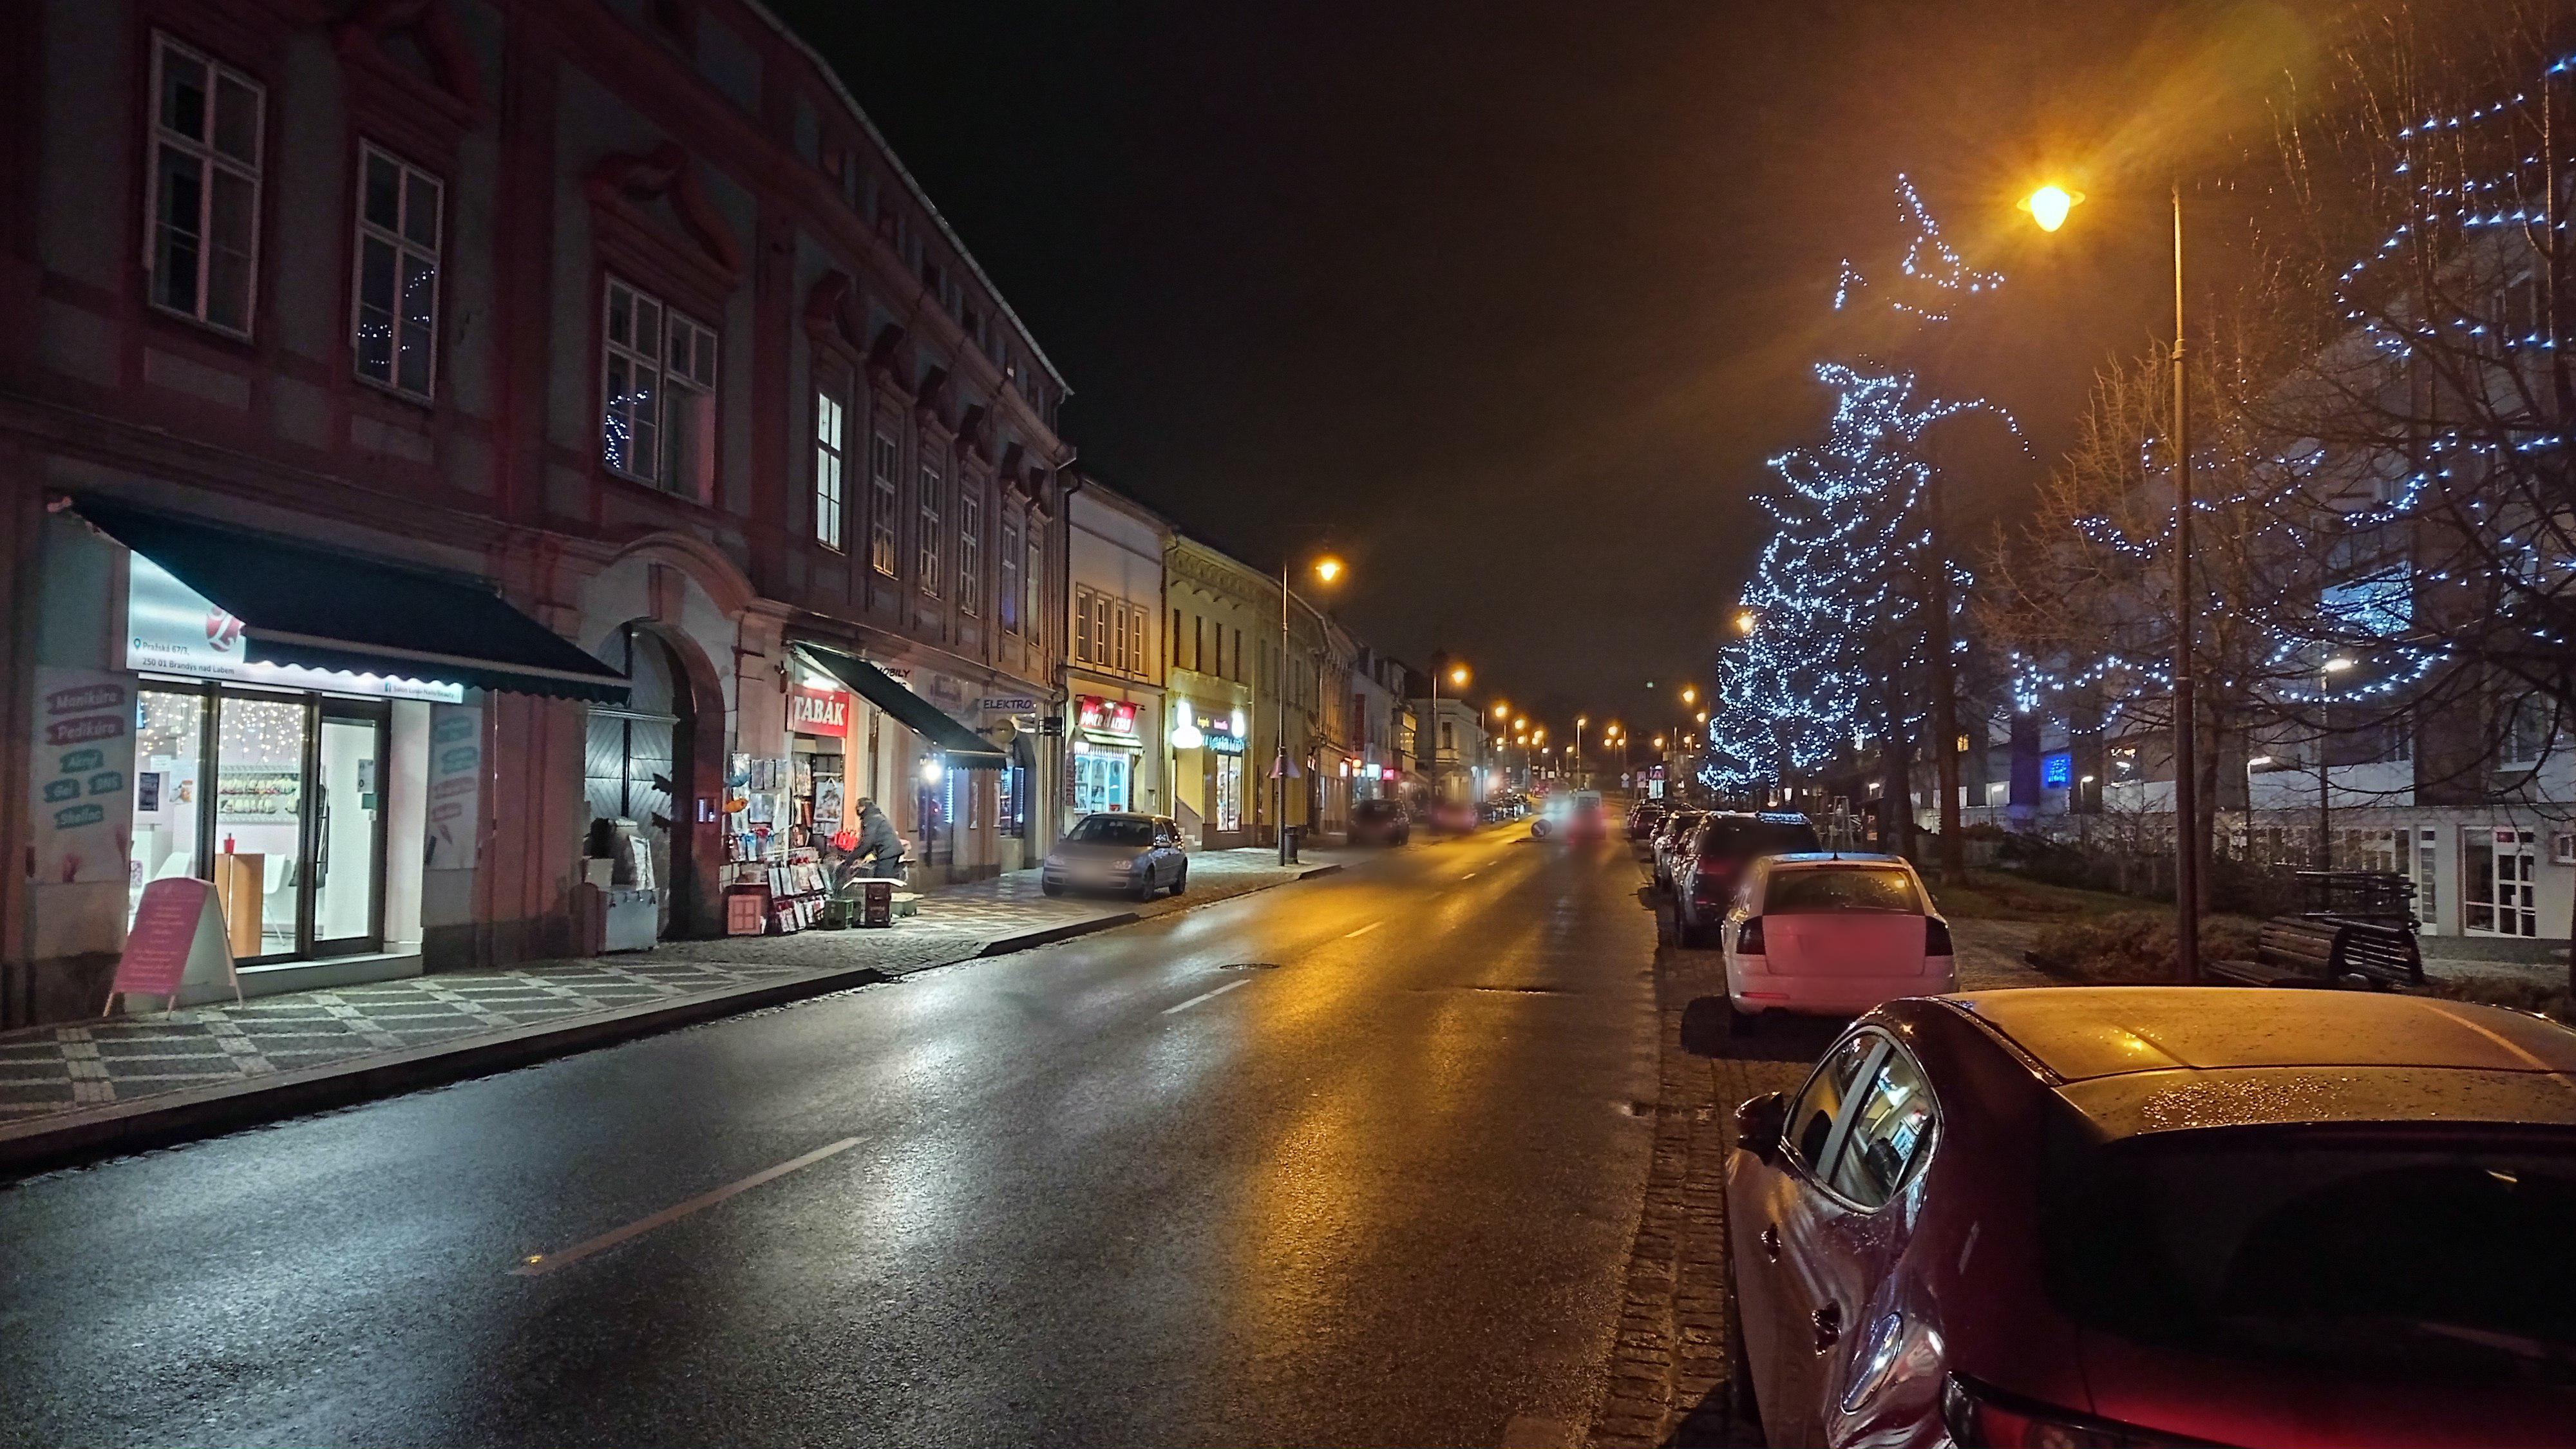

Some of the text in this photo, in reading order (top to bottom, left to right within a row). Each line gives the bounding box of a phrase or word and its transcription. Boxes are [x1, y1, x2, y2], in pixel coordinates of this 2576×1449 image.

[142, 658, 156, 666] 250
[213, 665, 234, 674] Labem
[880, 667, 911, 677] OBILY
[983, 699, 1031, 708] ELEKTRO
[794, 696, 845, 726] TABÁK
